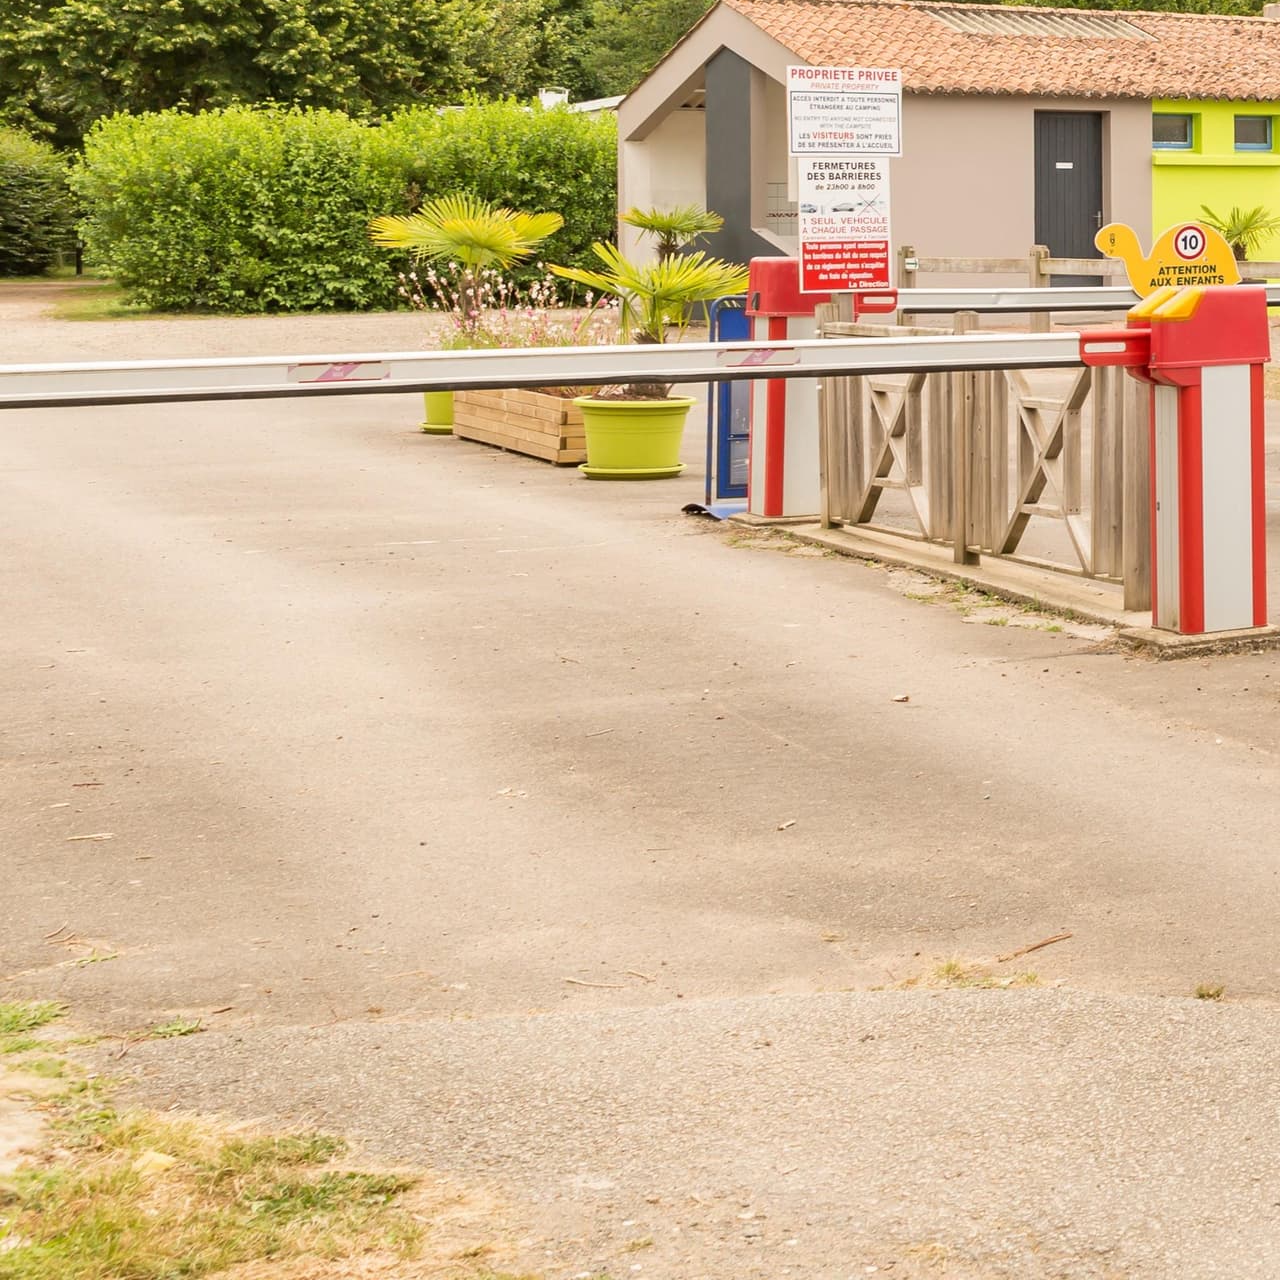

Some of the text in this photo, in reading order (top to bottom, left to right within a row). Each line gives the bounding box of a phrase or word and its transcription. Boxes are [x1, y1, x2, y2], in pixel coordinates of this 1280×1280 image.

[791, 69, 898, 81] PROPRIETE PRIVEE
[812, 132, 854, 140] VISITEURS
[812, 162, 876, 170] FERMETURES
[807, 172, 826, 180] DES
[812, 226, 847, 234] CHAQUE
[1181, 234, 1198, 250] 10
[1158, 265, 1216, 276] ATTENTION
[1150, 275, 1224, 287] AUX ENFANTS
